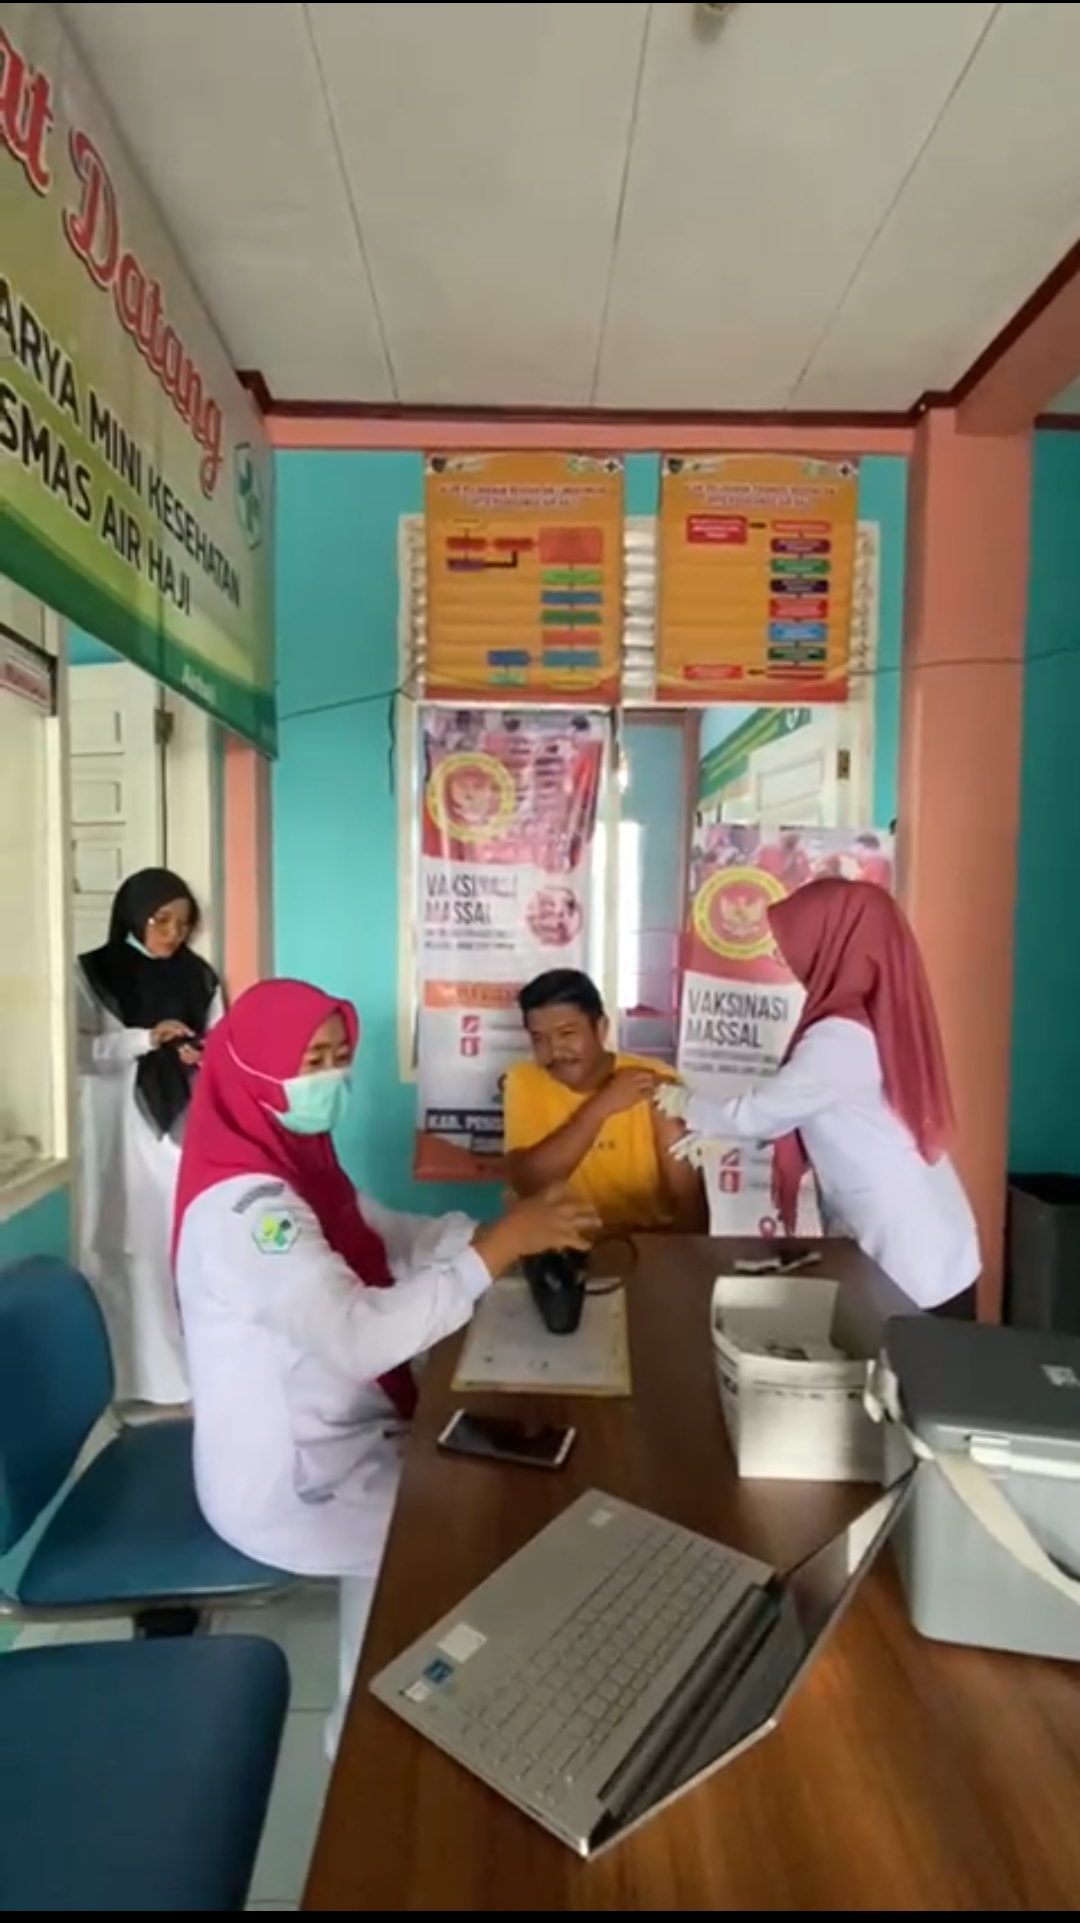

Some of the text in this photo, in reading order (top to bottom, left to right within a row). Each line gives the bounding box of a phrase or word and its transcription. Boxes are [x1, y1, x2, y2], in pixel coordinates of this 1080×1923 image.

[63, 126, 224, 500] Datang
[89, 390, 143, 495] MINI
[148, 464, 241, 606] KESEHATAN
[101, 495, 141, 571] AIR
[148, 537, 191, 615] HAJI
[686, 1017, 763, 1050] MASSAL
[688, 988, 788, 1021] VAKSINASI
